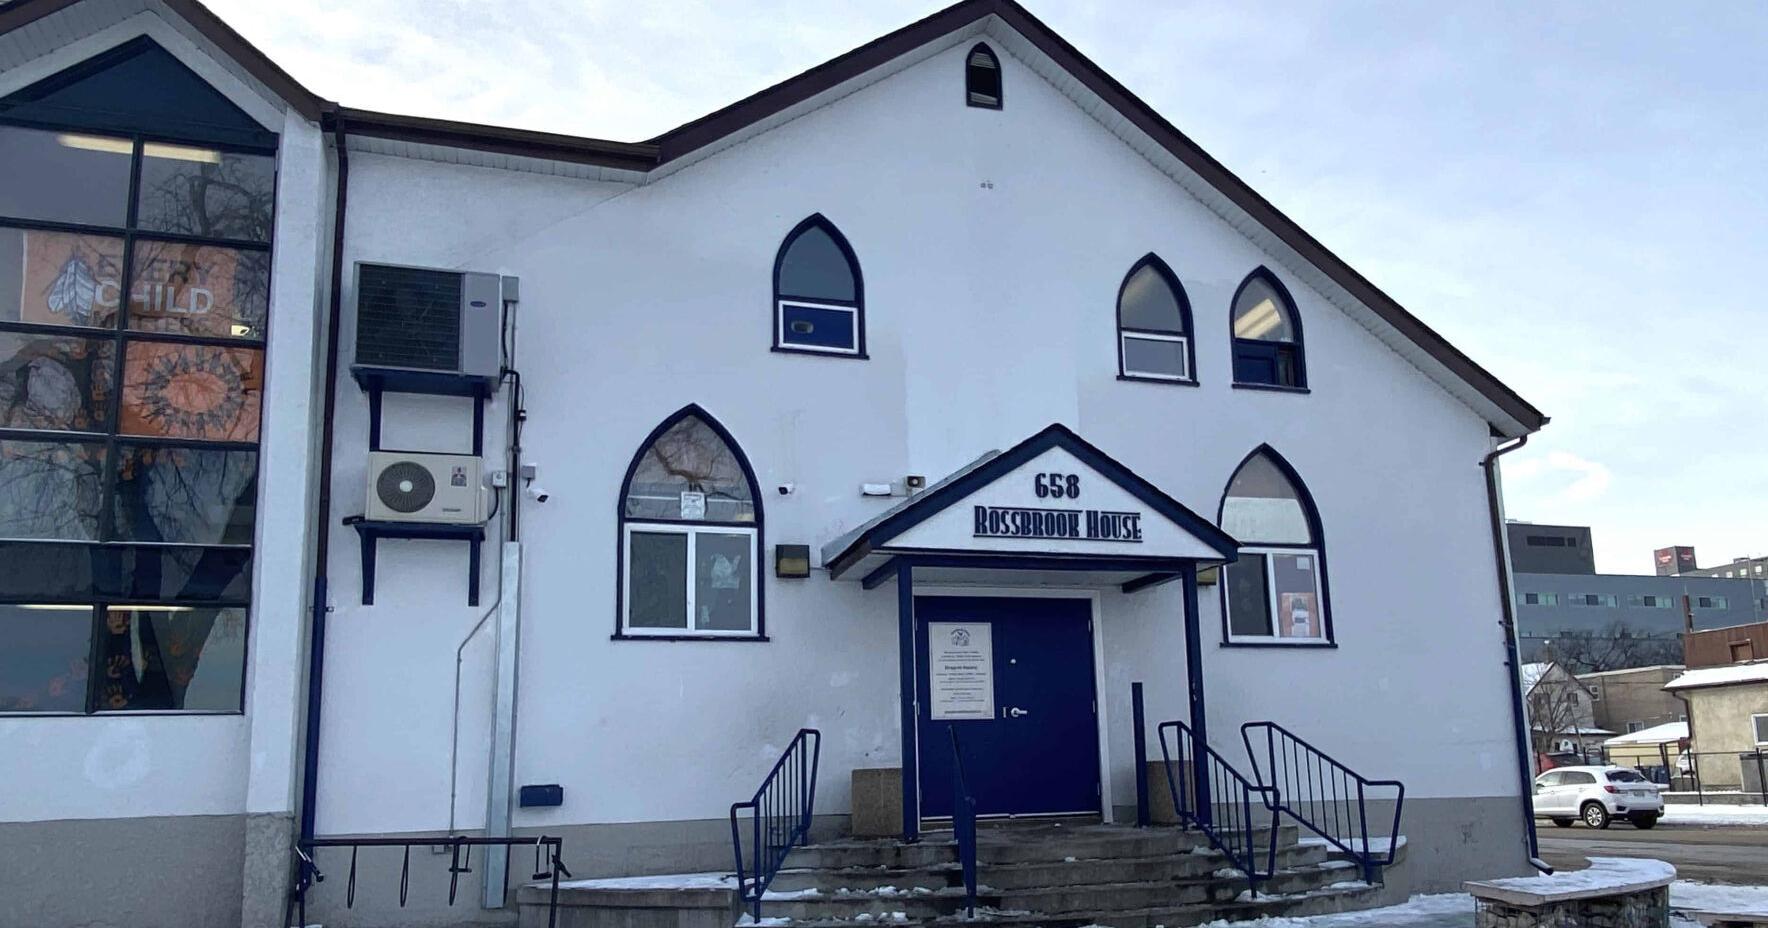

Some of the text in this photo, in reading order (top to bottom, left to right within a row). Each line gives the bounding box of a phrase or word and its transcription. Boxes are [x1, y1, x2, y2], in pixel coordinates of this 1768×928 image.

[1035, 473, 1080, 499] 658
[974, 505, 1142, 540] ROSSBROOK HOUSE
